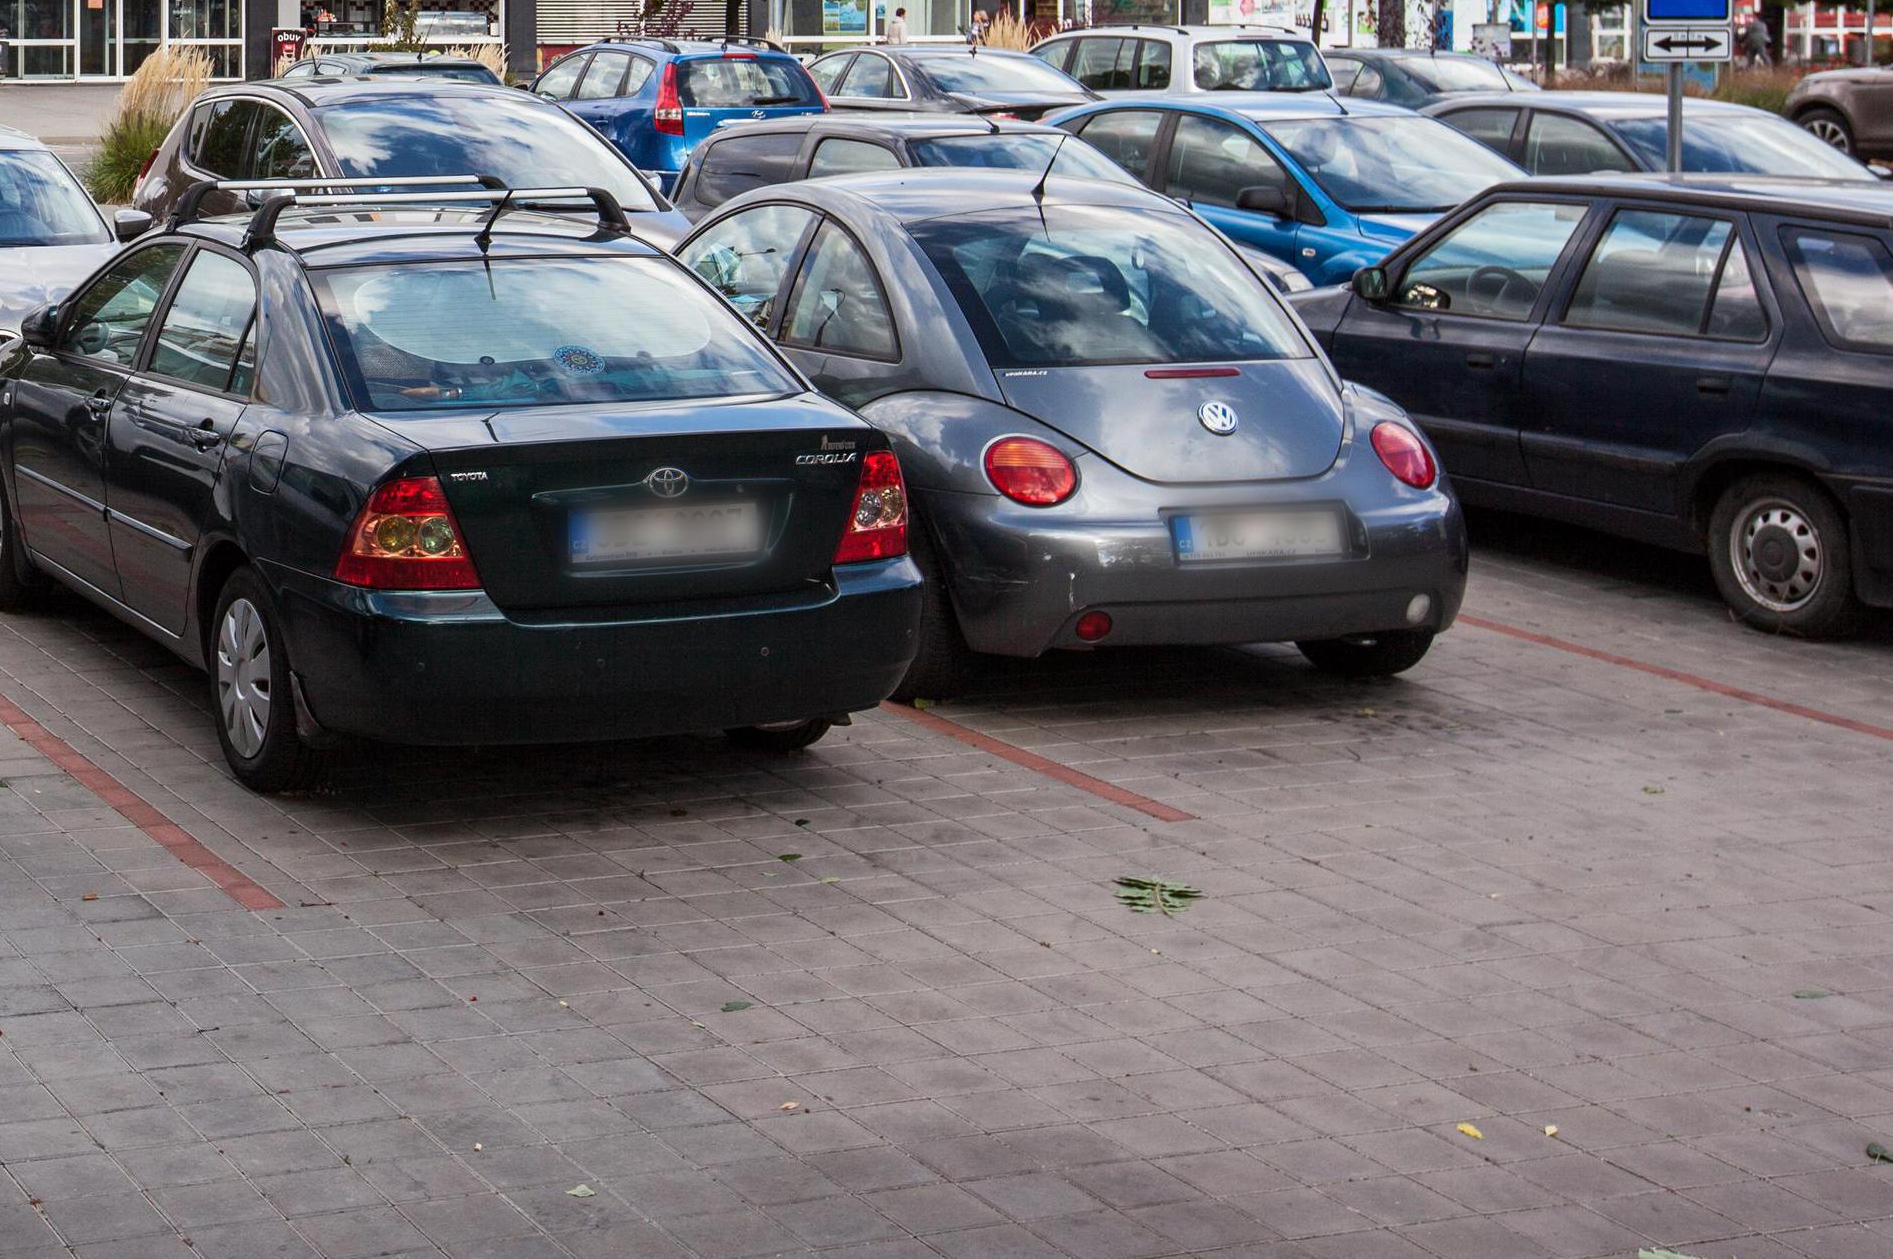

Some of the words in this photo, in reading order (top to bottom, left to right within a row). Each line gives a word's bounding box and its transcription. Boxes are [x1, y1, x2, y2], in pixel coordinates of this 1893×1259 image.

[277, 32, 301, 42] obuv
[796, 452, 857, 465] COROLLA
[450, 471, 488, 481] TOYOTA
[1179, 539, 1193, 549] CZ
